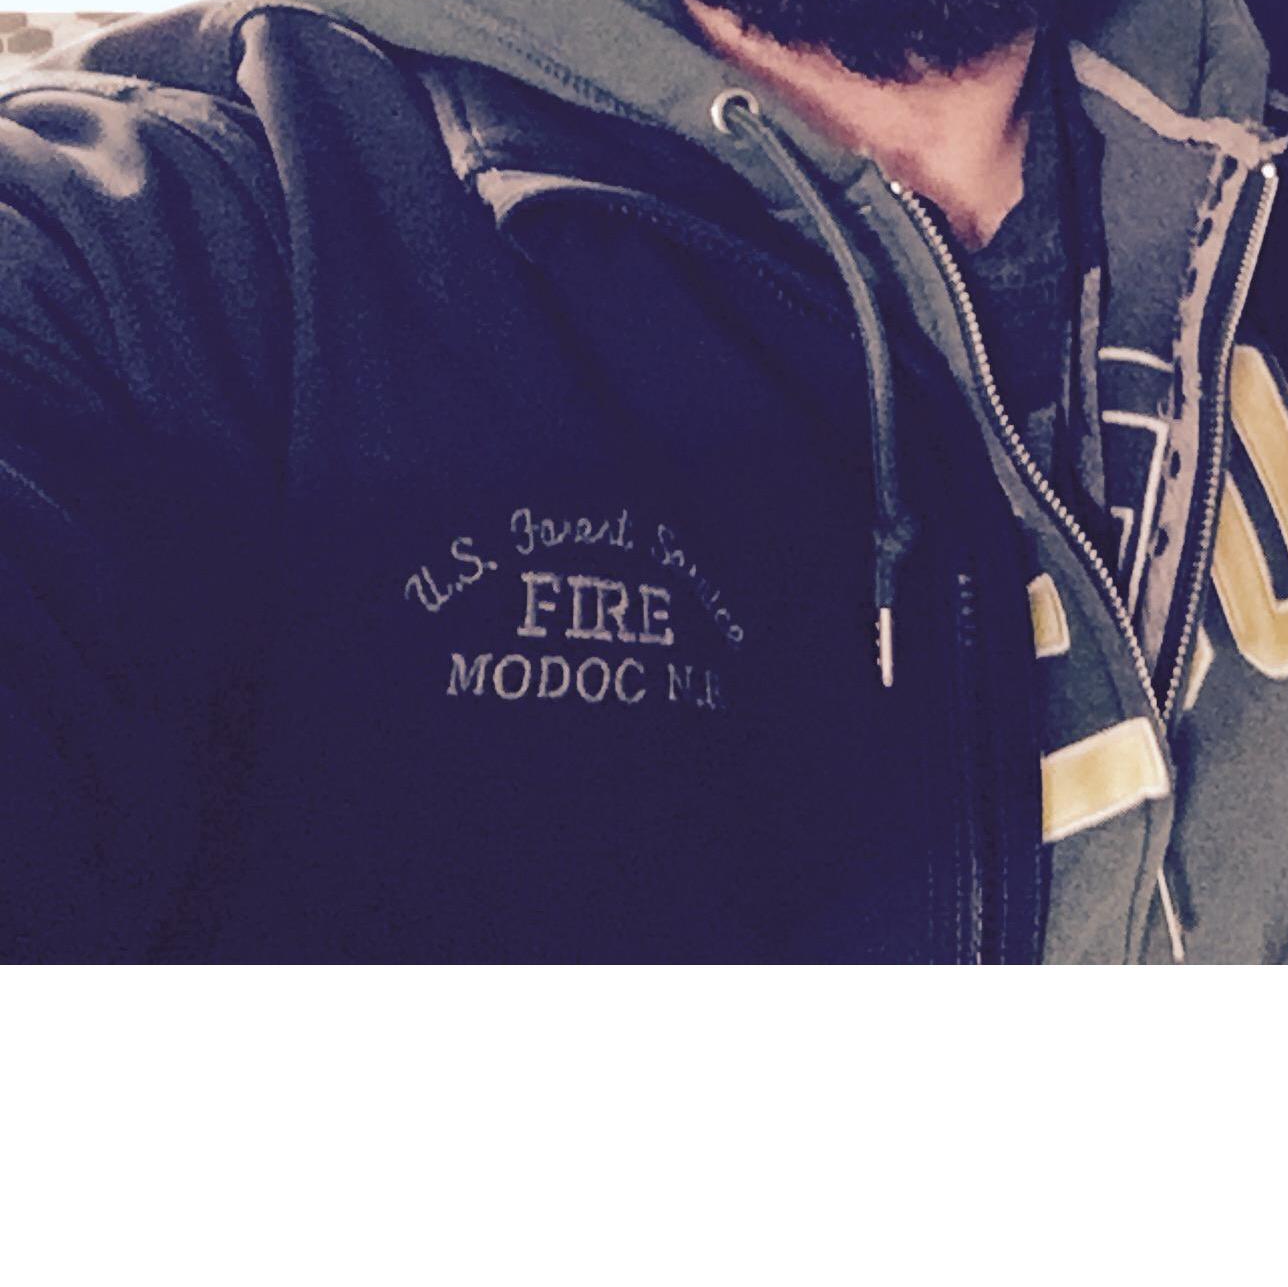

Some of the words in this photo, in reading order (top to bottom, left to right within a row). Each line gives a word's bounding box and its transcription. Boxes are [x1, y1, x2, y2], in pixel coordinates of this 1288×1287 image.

[404, 535, 499, 613] U.S.
[516, 570, 675, 647] FIRE
[446, 652, 646, 704] MODOC
